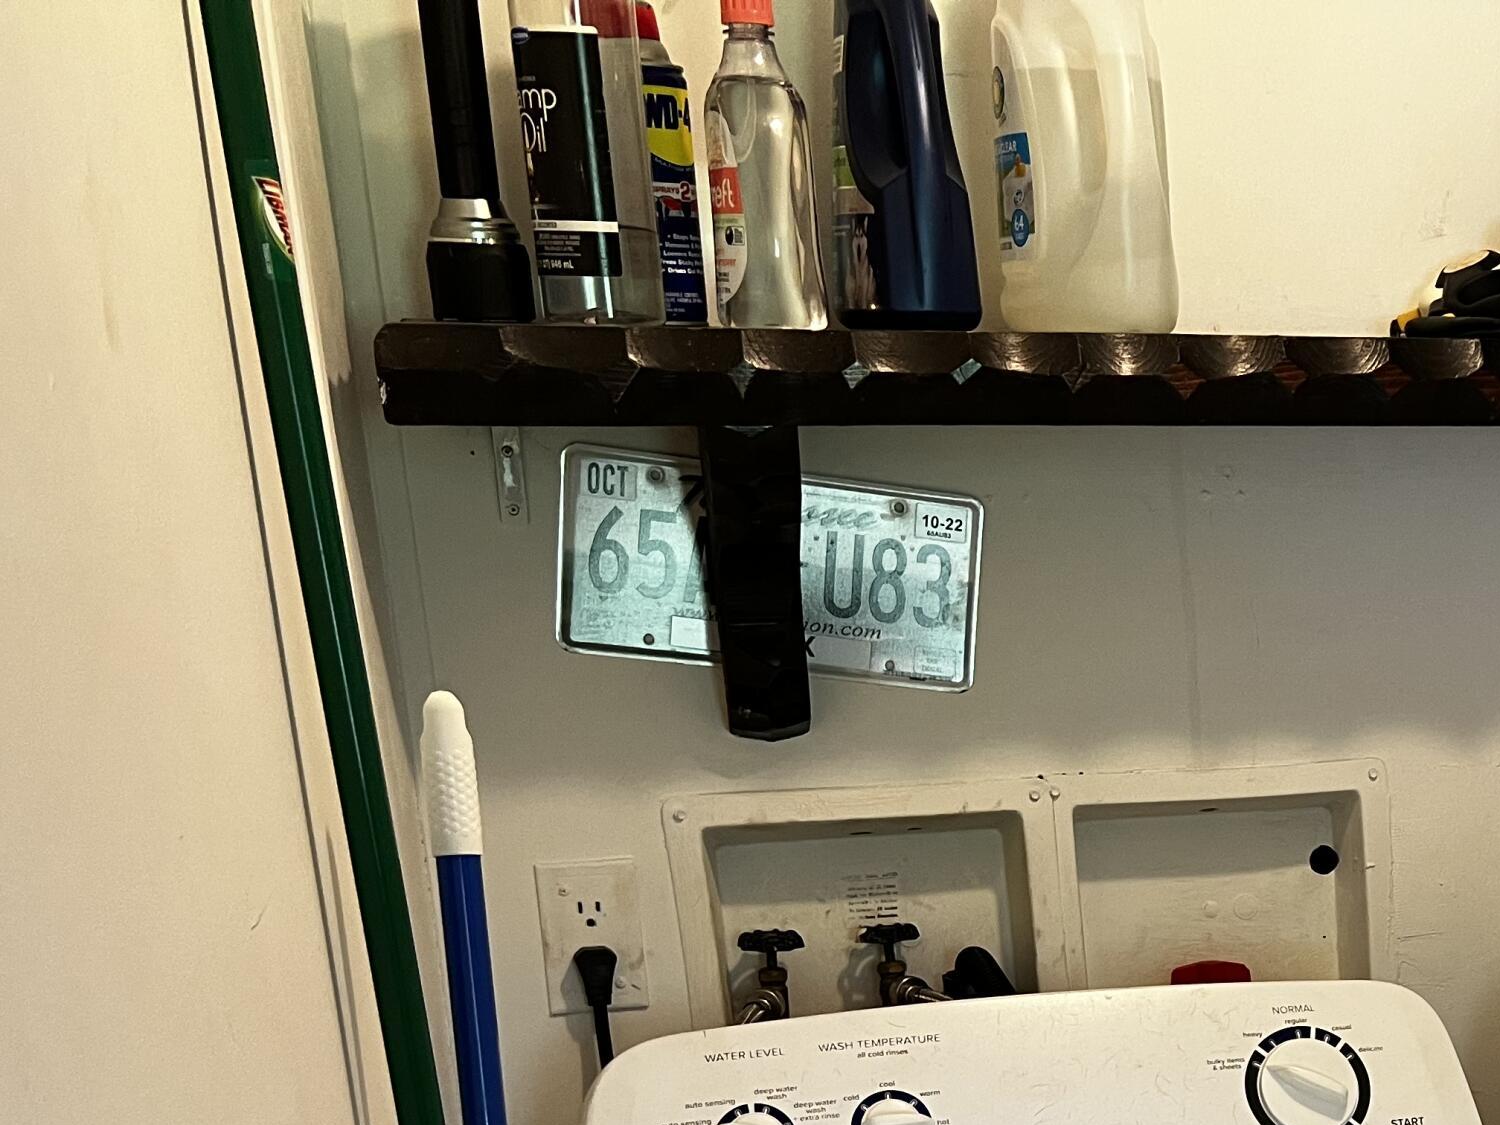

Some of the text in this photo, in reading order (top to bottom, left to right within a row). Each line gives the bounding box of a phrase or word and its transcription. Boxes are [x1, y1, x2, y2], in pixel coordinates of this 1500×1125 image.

[588, 462, 628, 497] OCT
[922, 514, 963, 532] 10-22
[1272, 1005, 1315, 1014] NORMAL
[818, 1034, 941, 1052] WASH TEMPERATURE
[704, 1048, 785, 1063] WATER LEVEL
[705, 1099, 735, 1107] sensing
